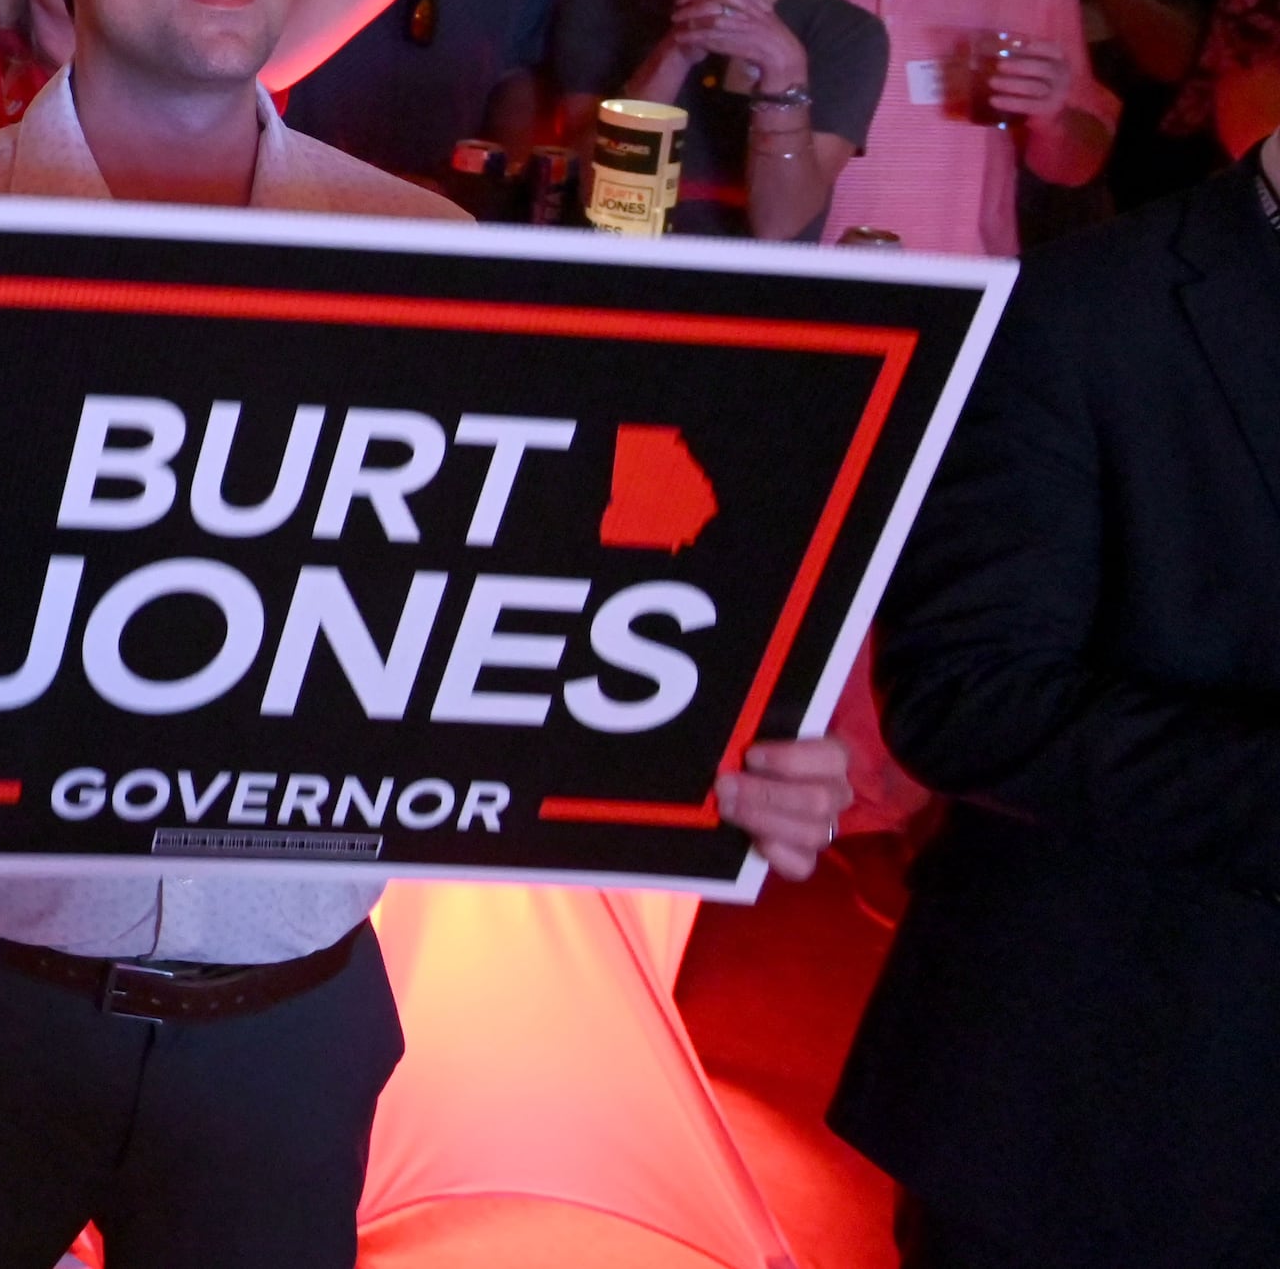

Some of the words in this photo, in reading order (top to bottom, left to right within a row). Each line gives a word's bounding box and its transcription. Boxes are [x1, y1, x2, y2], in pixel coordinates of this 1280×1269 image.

[599, 198, 646, 215] JONES
[55, 393, 579, 548] BURT
[49, 766, 512, 833] GOVERNOR
